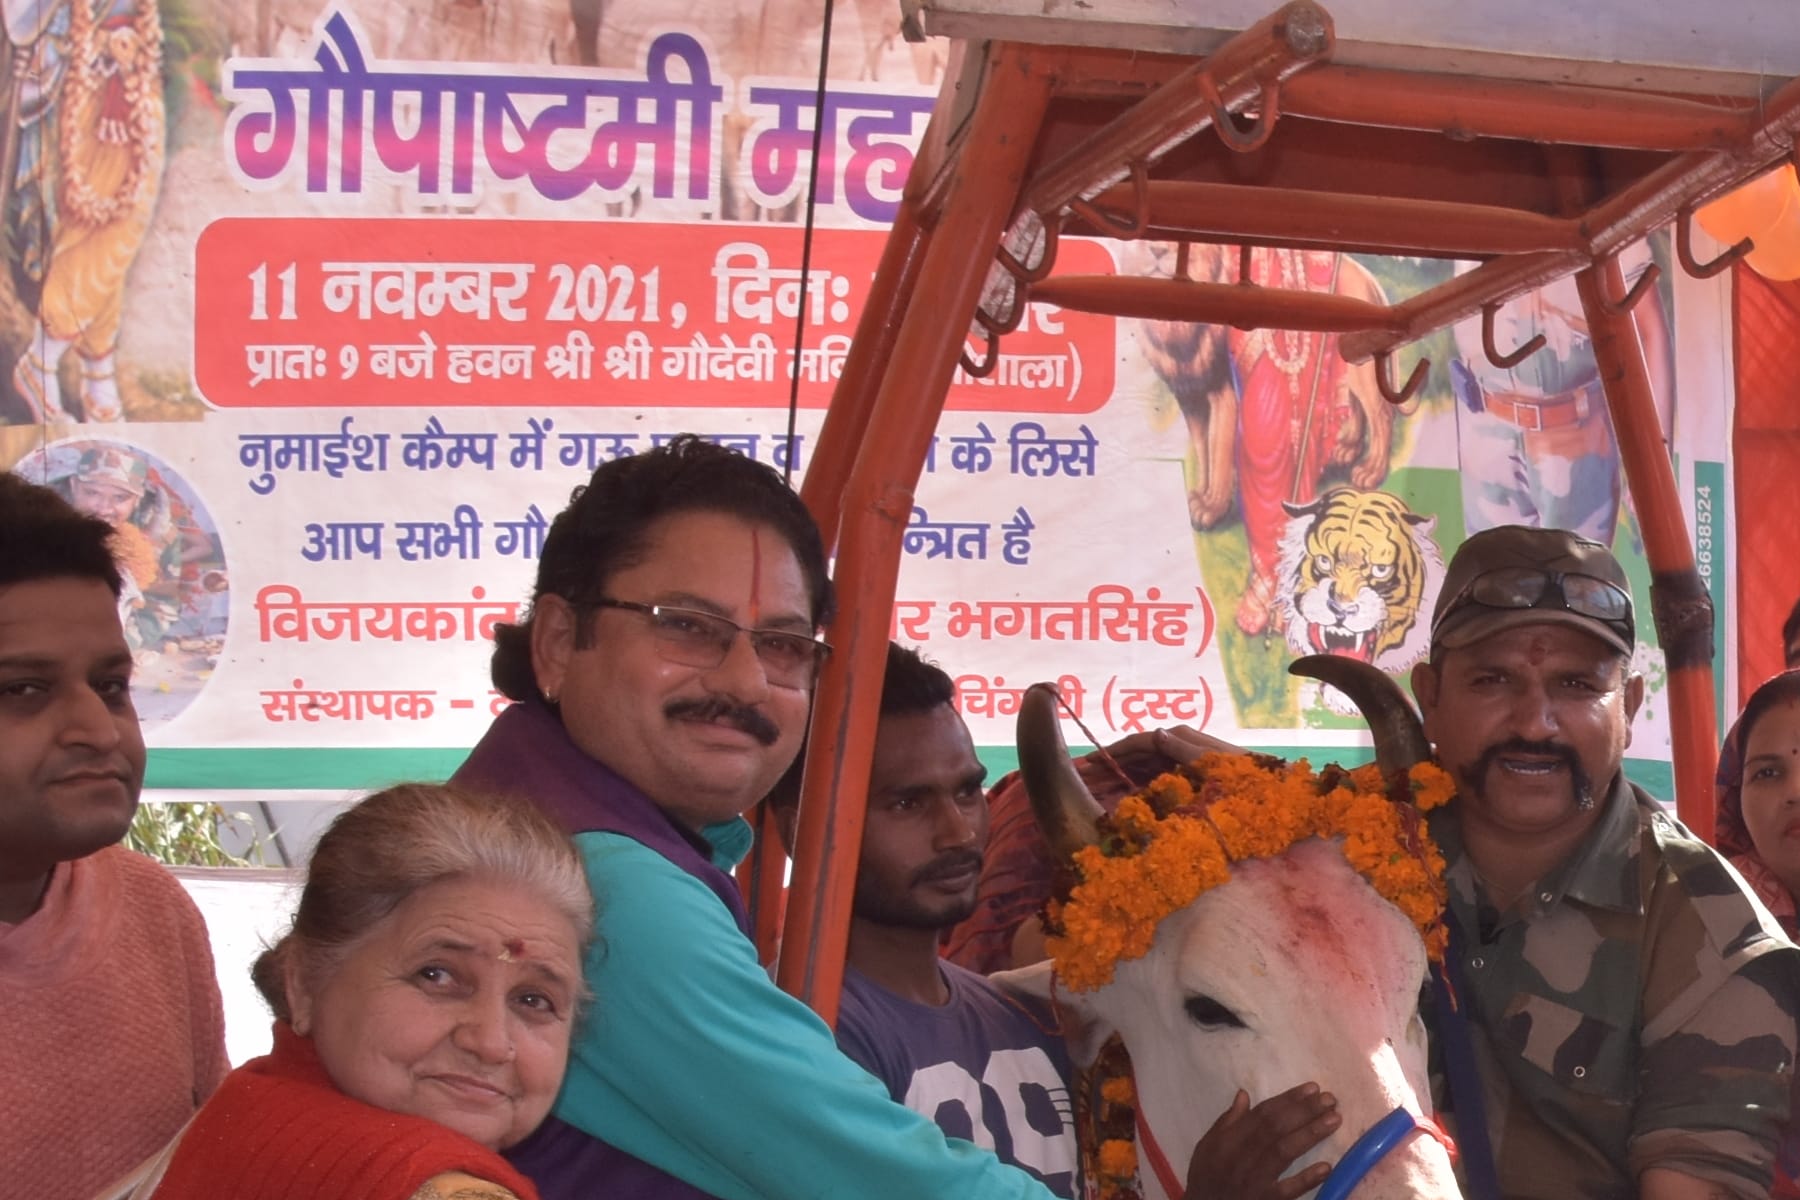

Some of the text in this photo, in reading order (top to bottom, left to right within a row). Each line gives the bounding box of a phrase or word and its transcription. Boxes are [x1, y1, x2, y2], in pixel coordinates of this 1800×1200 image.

[233, 10, 723, 201] गौपाष्टमी
[247, 261, 298, 321] 11
[321, 261, 535, 321] नवम्बर
[545, 263, 688, 328] 2021,
[369, 330, 437, 381] बजे
[447, 344, 535, 384] हवन
[544, 331, 594, 381] श्री
[604, 331, 653, 381] श्री
[661, 332, 777, 382] गौदेवी
[238, 416, 391, 495] नुमाईश
[401, 415, 498, 471] कैम्प
[509, 418, 554, 470] में
[950, 422, 996, 473] के
[301, 521, 384, 562] आप
[395, 504, 483, 561] सभी
[1001, 505, 1036, 565] है
[260, 678, 437, 723] संस्थापक
